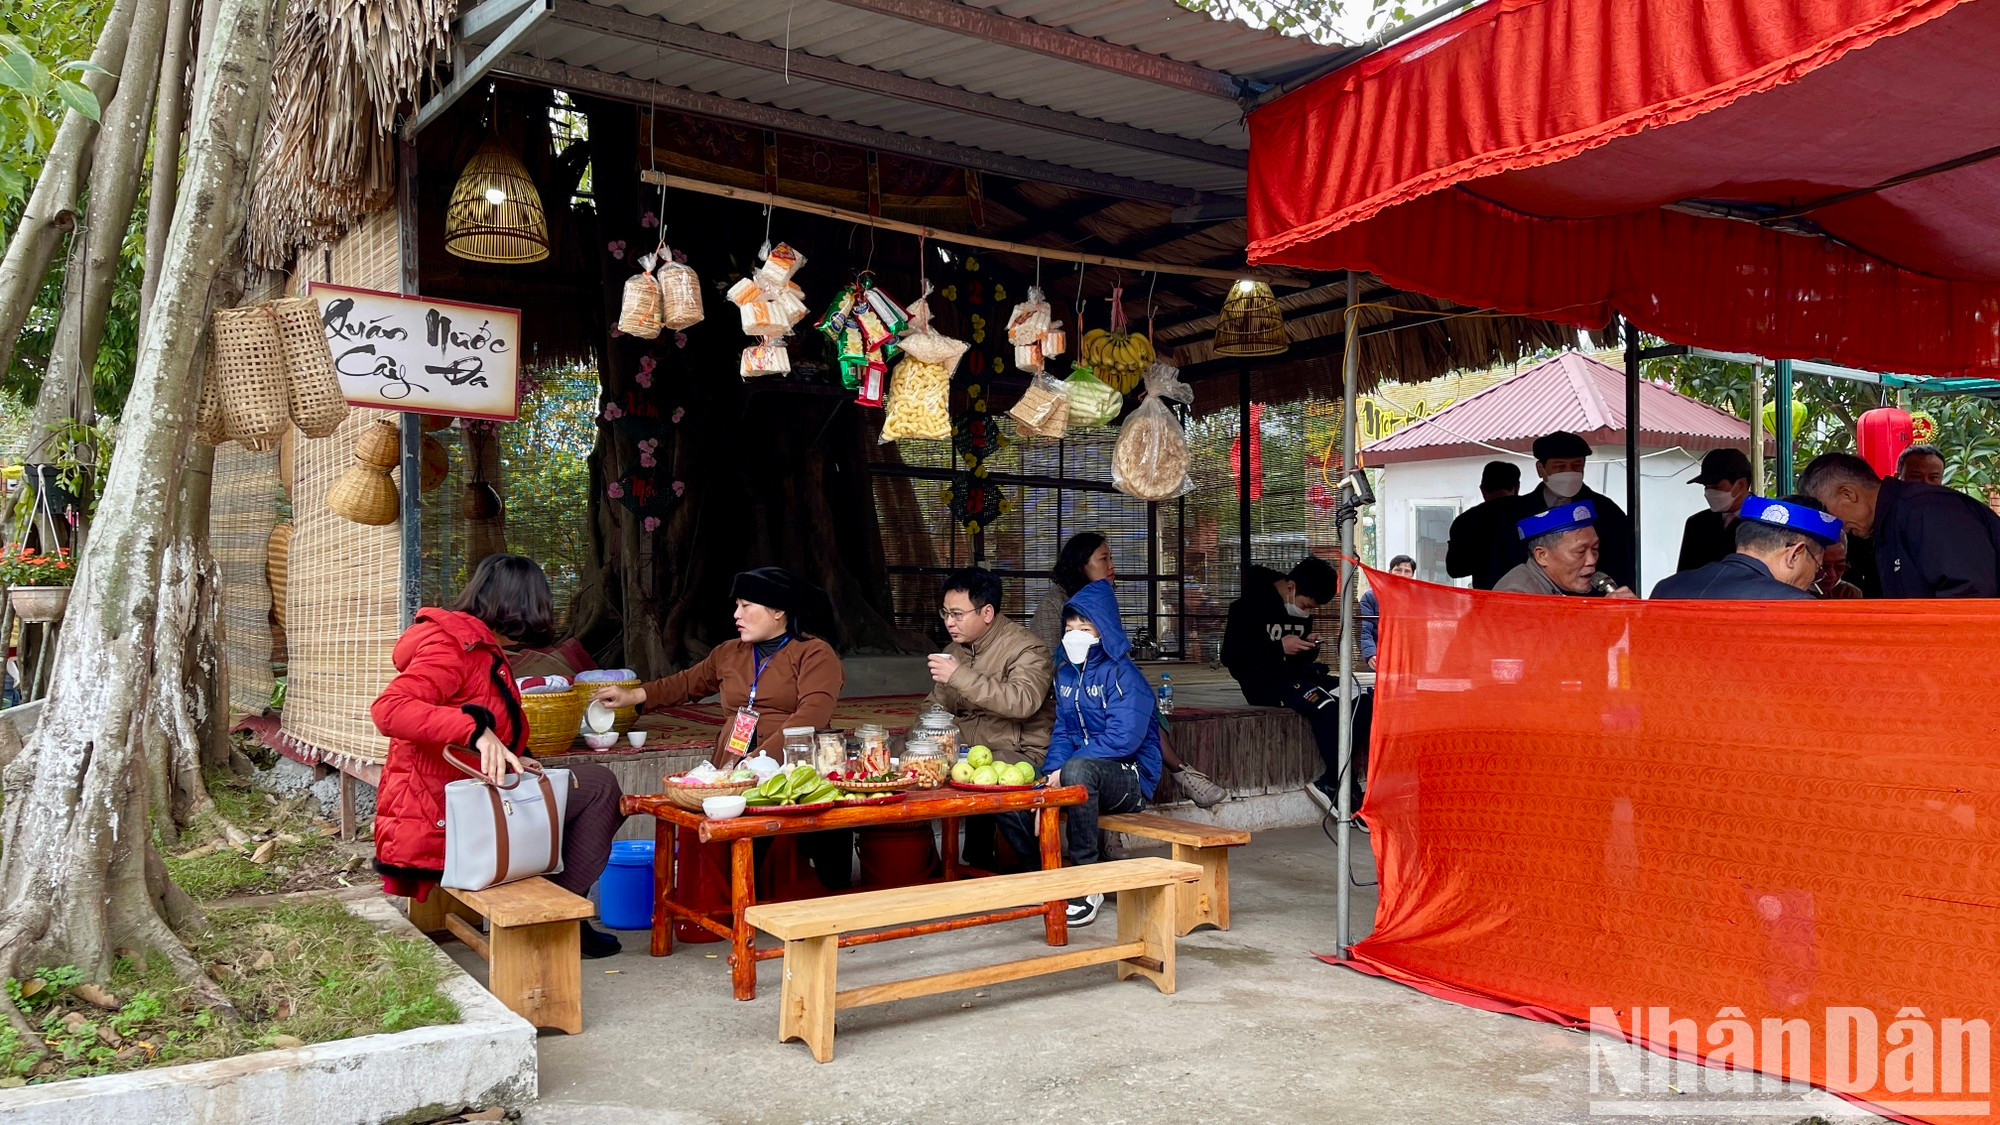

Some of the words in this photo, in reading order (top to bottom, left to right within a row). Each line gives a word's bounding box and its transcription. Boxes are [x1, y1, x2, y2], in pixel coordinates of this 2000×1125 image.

[323, 298, 408, 341] Quán
[426, 308, 511, 357] Nước
[335, 344, 430, 399] Cây
[425, 356, 489, 388] Đa
